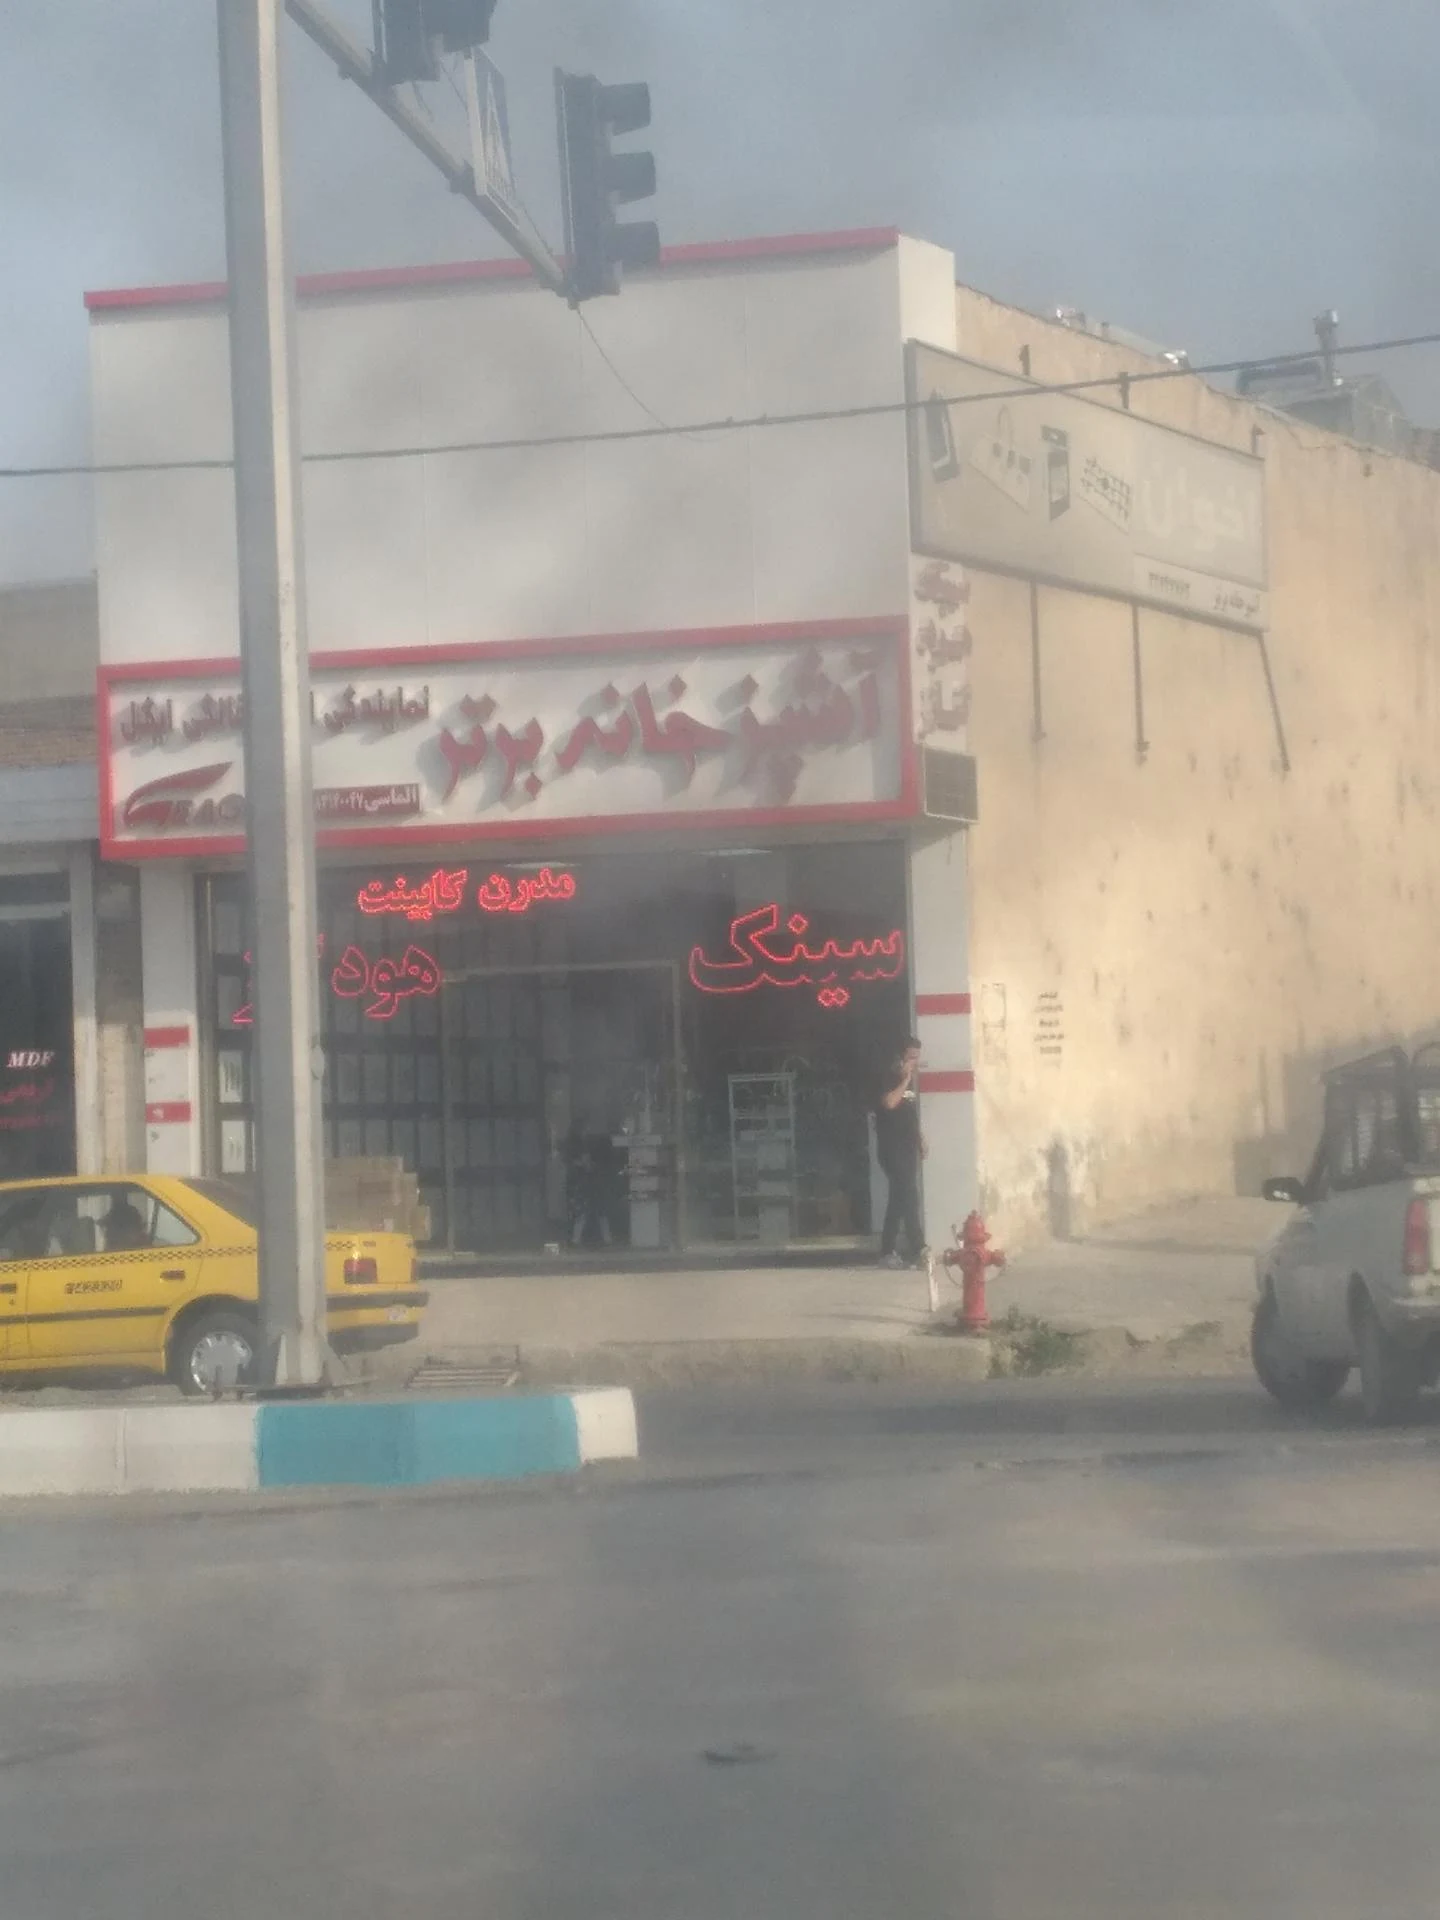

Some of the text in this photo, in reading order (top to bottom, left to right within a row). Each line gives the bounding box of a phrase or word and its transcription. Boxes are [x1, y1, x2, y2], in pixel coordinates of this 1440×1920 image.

[323, 684, 430, 734] نمایندگی
[438, 693, 545, 805] برتر
[356, 867, 577, 921] مدرن کابینت
[331, 944, 442, 1020] هود
[687, 902, 905, 1008] سینک
[6, 1048, 55, 1069] MDF
